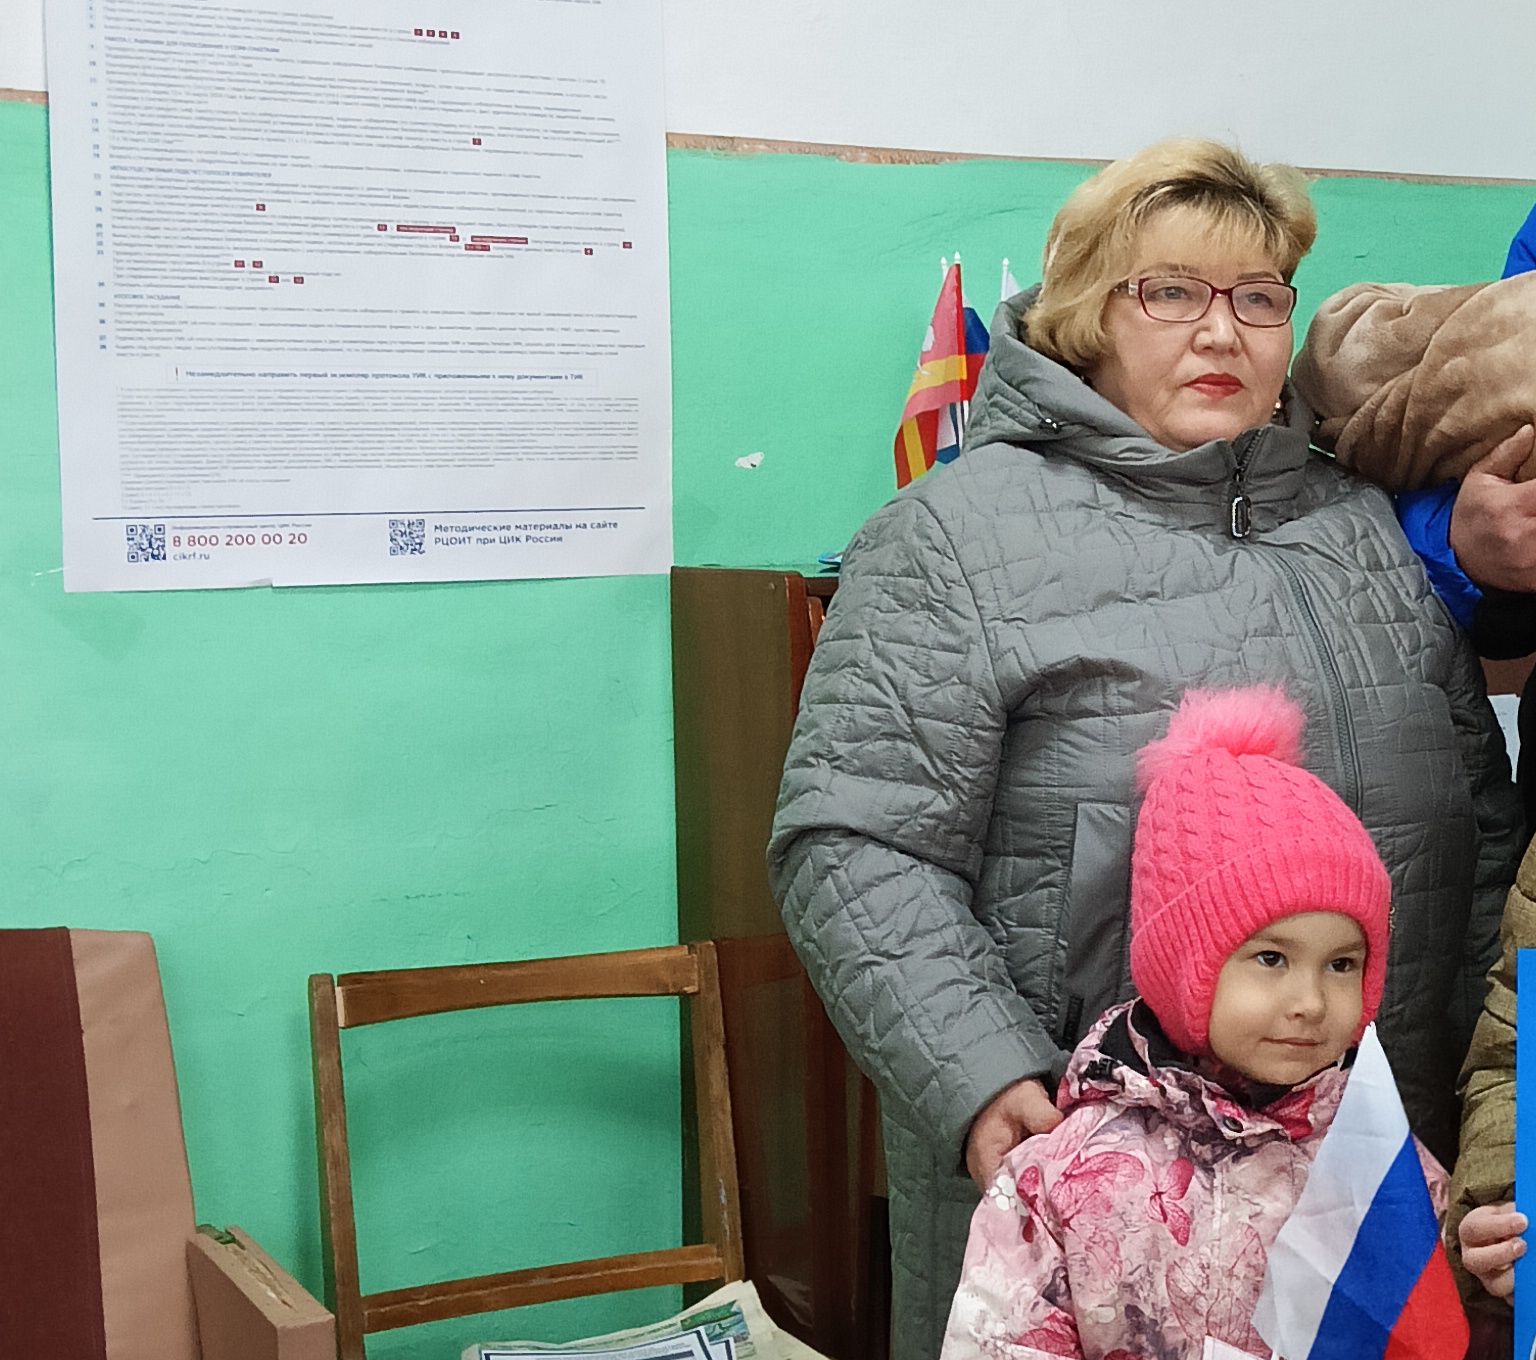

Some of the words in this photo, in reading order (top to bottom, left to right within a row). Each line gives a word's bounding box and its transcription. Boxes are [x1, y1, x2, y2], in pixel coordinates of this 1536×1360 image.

[434, 523, 511, 533] Методические
[515, 522, 572, 532] материалы
[575, 522, 587, 530] на
[590, 520, 618, 530] сайте
[172, 535, 181, 547] 8
[187, 534, 219, 547] 800
[225, 534, 256, 546] 200
[261, 533, 283, 545] 00
[288, 532, 308, 545] 20
[434, 536, 472, 546] РЦОИТ
[476, 537, 496, 546] при
[499, 535, 522, 545] ЦИК
[525, 534, 563, 544] России
[172, 551, 210, 561] cikrf.ru
